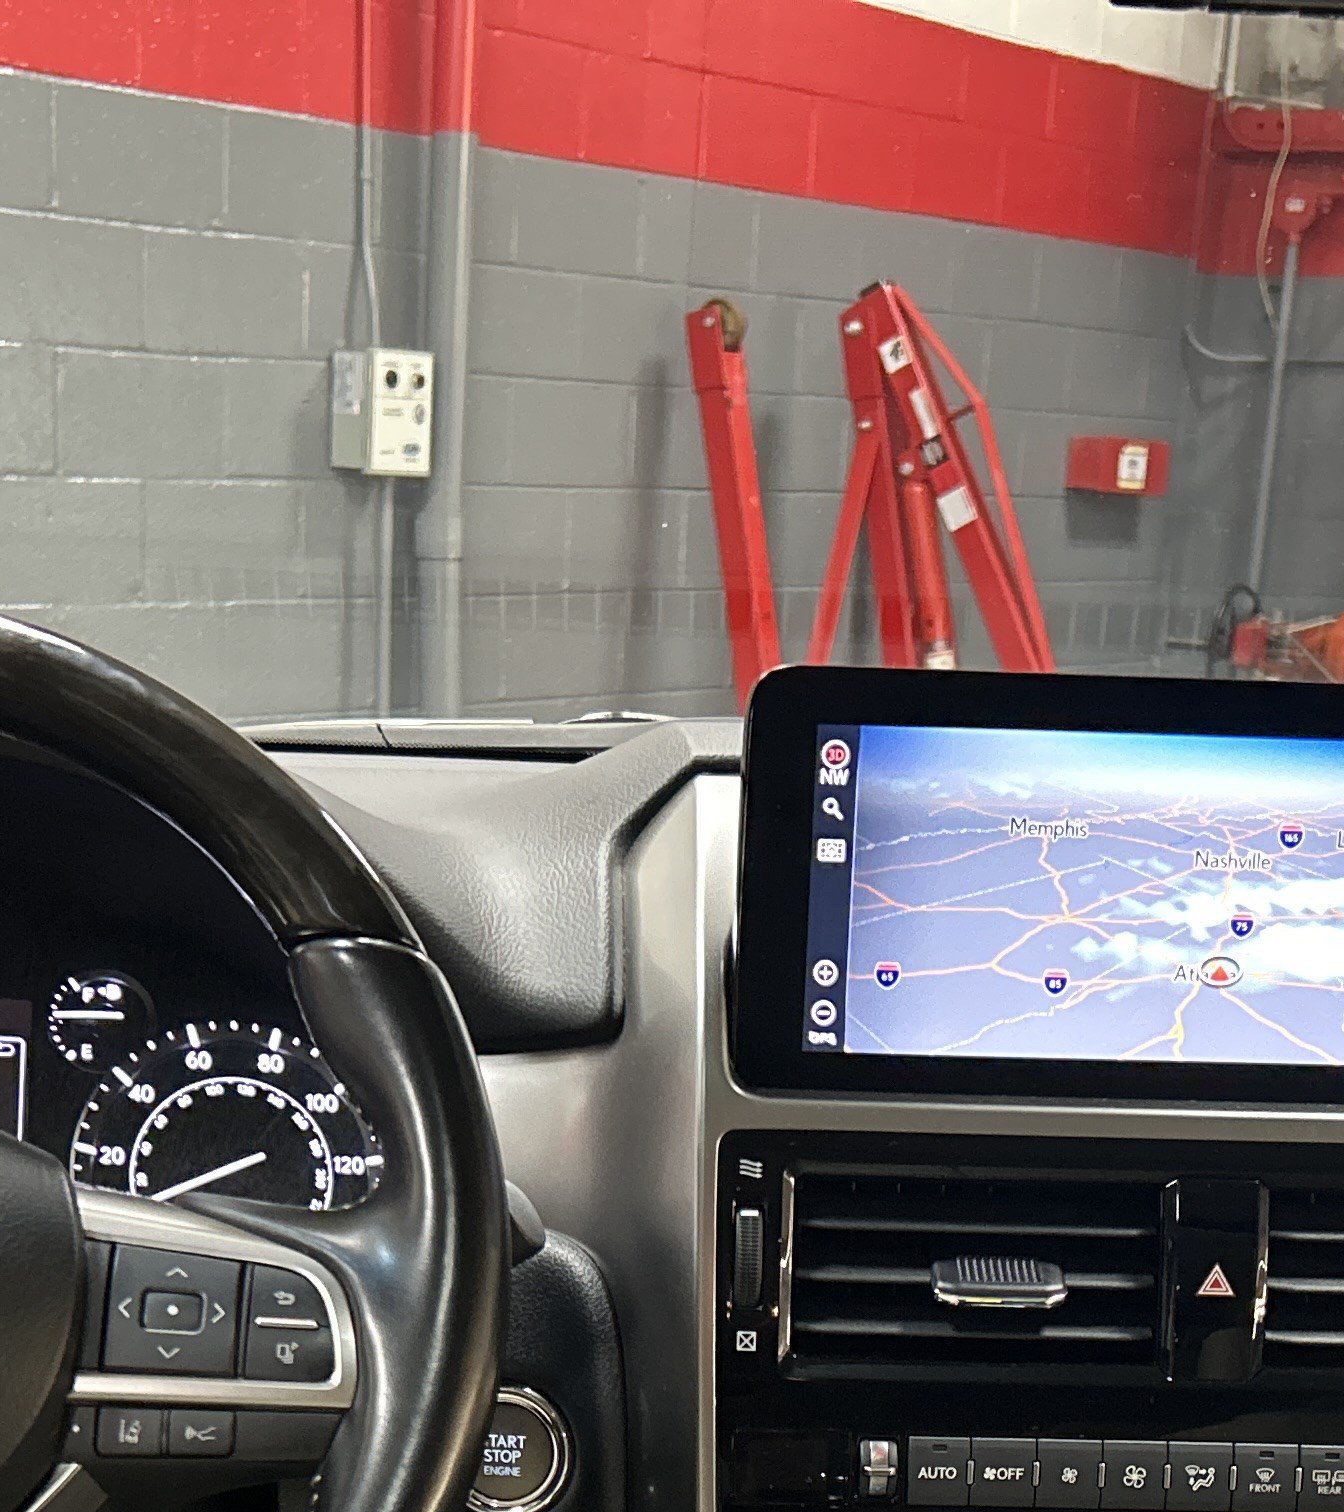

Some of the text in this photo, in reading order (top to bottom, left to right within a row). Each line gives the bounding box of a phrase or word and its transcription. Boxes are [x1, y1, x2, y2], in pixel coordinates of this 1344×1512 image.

[819, 767, 850, 786] NW
[1009, 817, 1088, 840] Memphis
[1194, 850, 1272, 870] Nashville
[1236, 921, 1248, 931] 75
[81, 1043, 94, 1061] E
[185, 1051, 213, 1071] 60
[257, 1053, 285, 1075] 80
[127, 1083, 156, 1104] 40
[304, 1092, 340, 1114] 100
[98, 1145, 125, 1166] 20
[333, 1155, 366, 1176] 120
[484, 1433, 527, 1449] TART
[483, 1448, 522, 1464] STOP
[483, 1464, 522, 1477] ENGINE
[918, 1466, 957, 1481] AUTO
[997, 1466, 1025, 1481] OFF
[1249, 1482, 1281, 1495] FRONT
[1317, 1485, 1343, 1497] REAR
